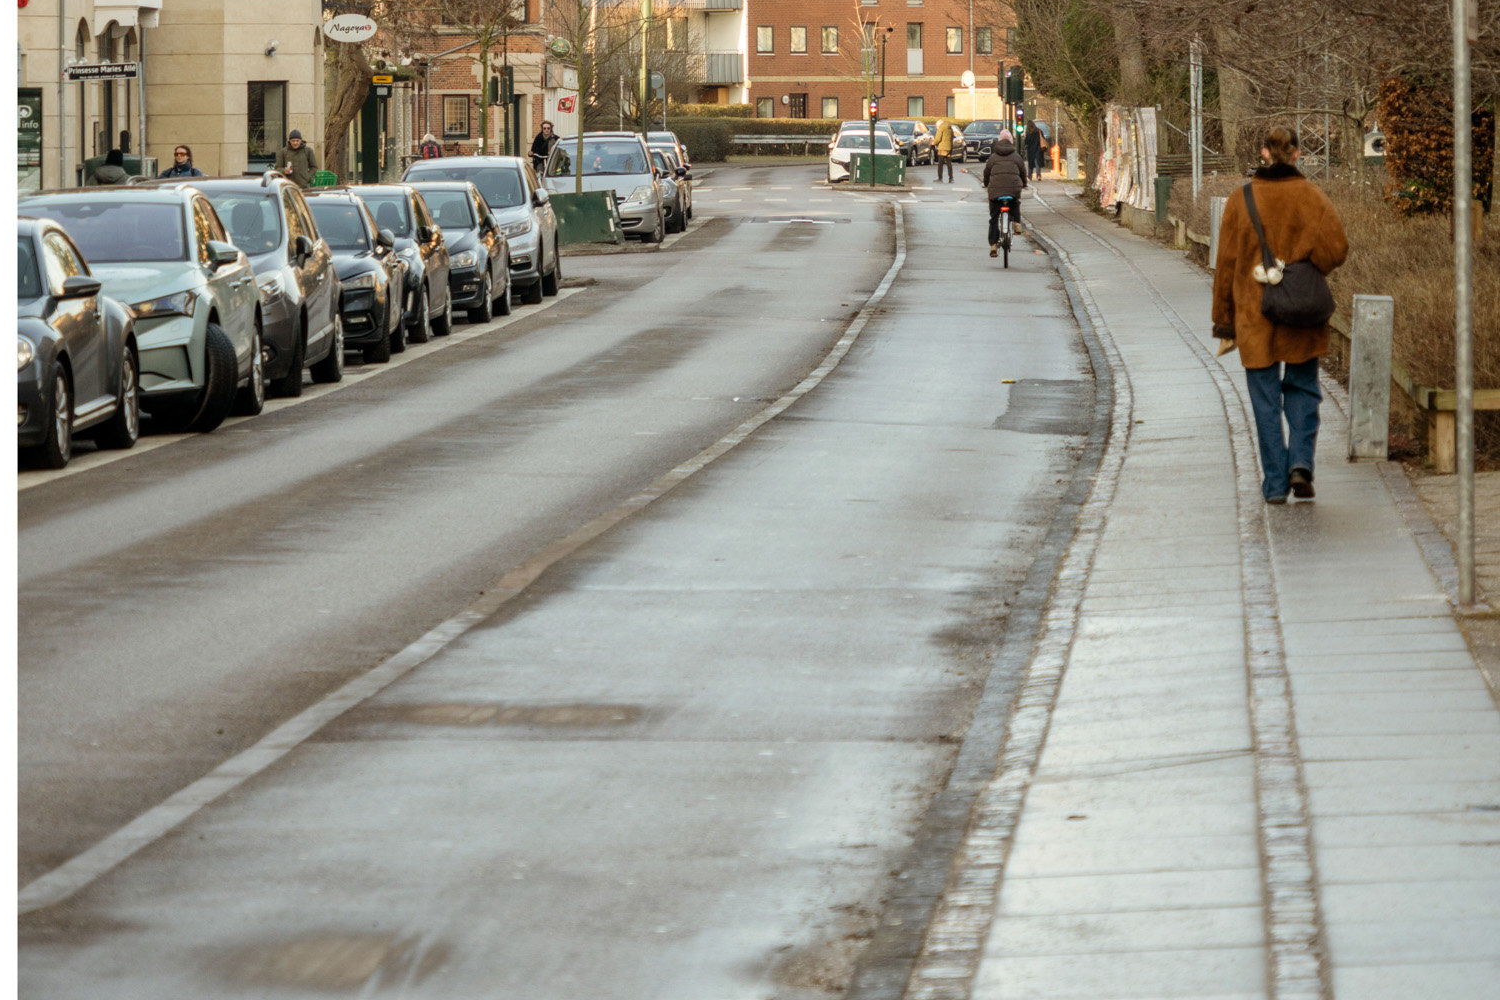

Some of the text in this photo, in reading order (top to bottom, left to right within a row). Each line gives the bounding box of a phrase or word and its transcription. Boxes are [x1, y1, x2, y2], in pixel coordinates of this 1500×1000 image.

[329, 23, 365, 34] Nagoya
[68, 64, 136, 75] Prinsesse Maries Allé
[21, 119, 39, 129] info
